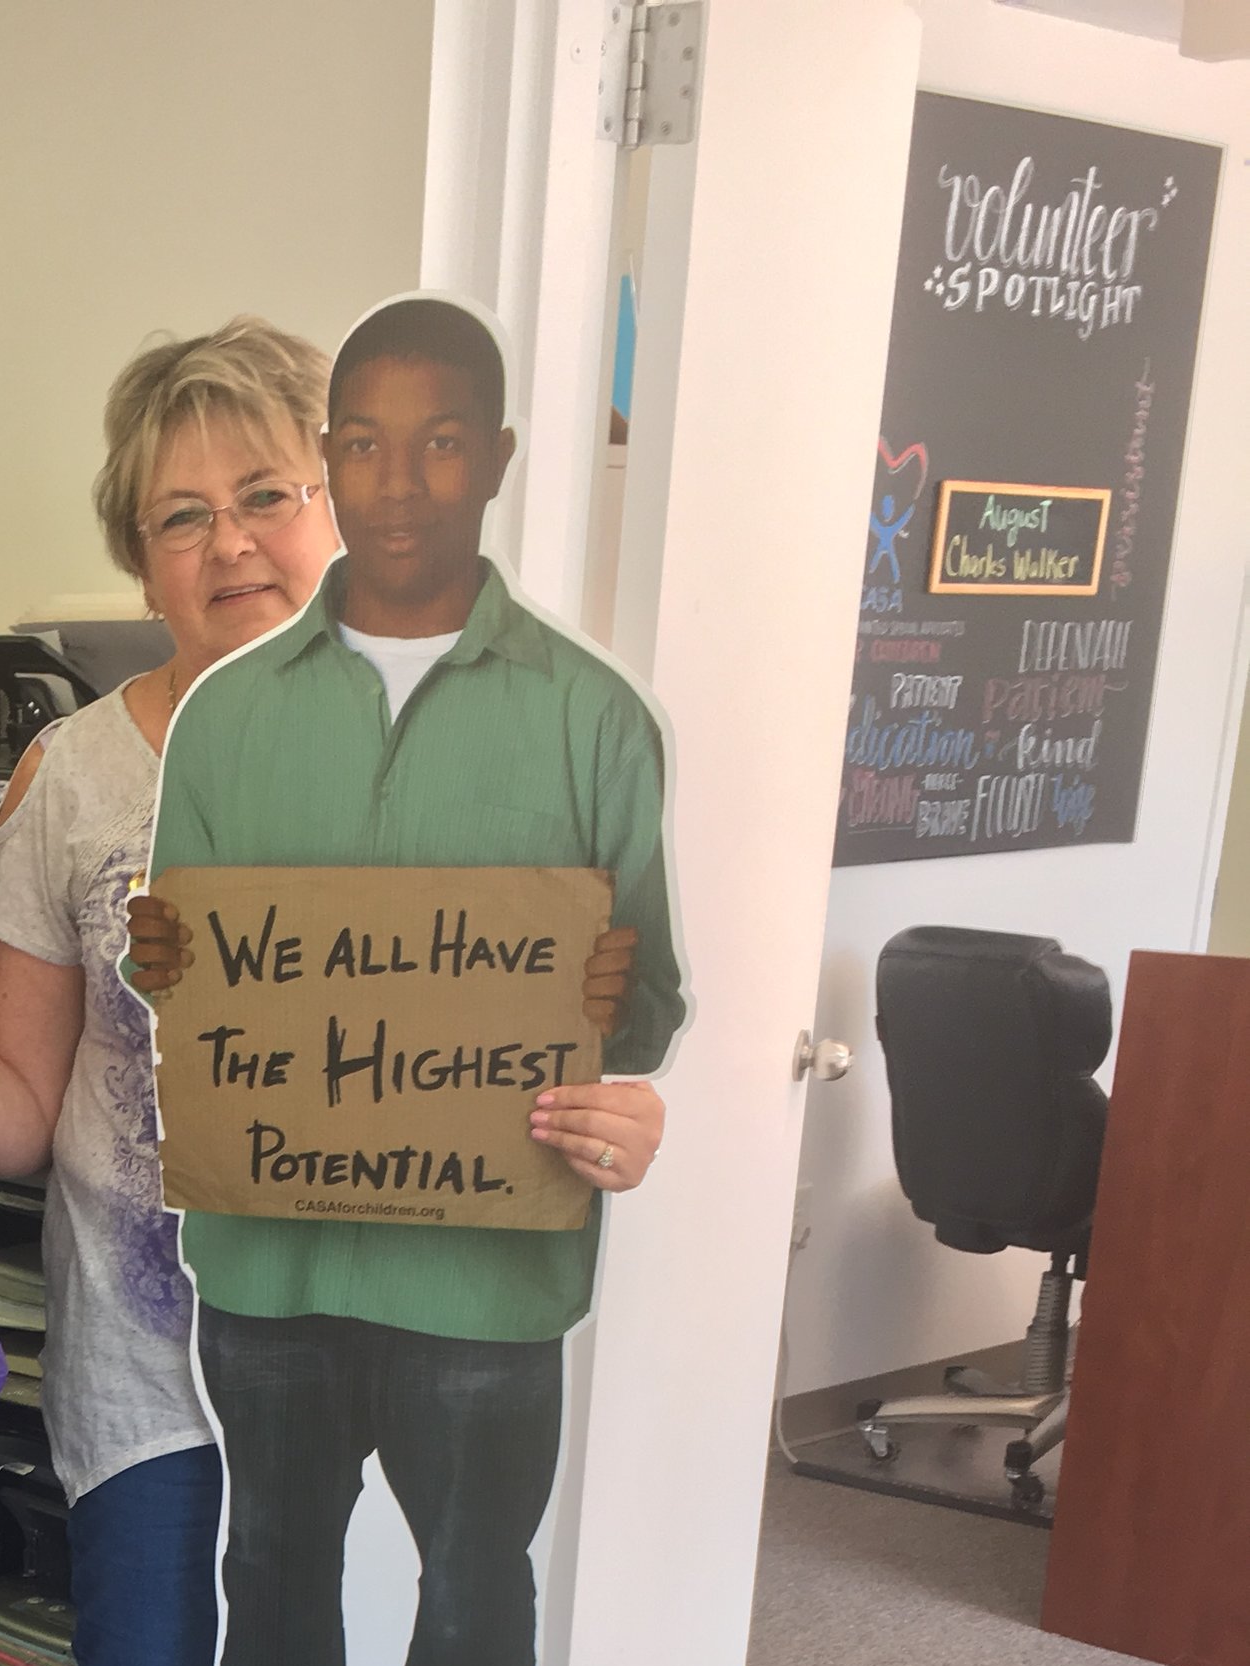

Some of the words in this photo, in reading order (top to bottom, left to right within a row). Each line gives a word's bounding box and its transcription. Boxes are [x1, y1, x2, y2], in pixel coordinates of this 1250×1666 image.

[939, 156, 1158, 284] Volunteer
[943, 262, 1143, 341] SPOTLIGHT
[861, 586, 903, 613] ASA
[846, 694, 981, 771] dication
[207, 904, 305, 988] WE
[324, 926, 419, 979] ALL
[430, 908, 557, 978] HAVE
[198, 1025, 295, 1090] THE
[322, 1015, 578, 1108] HIGHEST
[295, 1199, 445, 1221] CASAforchildren.org
